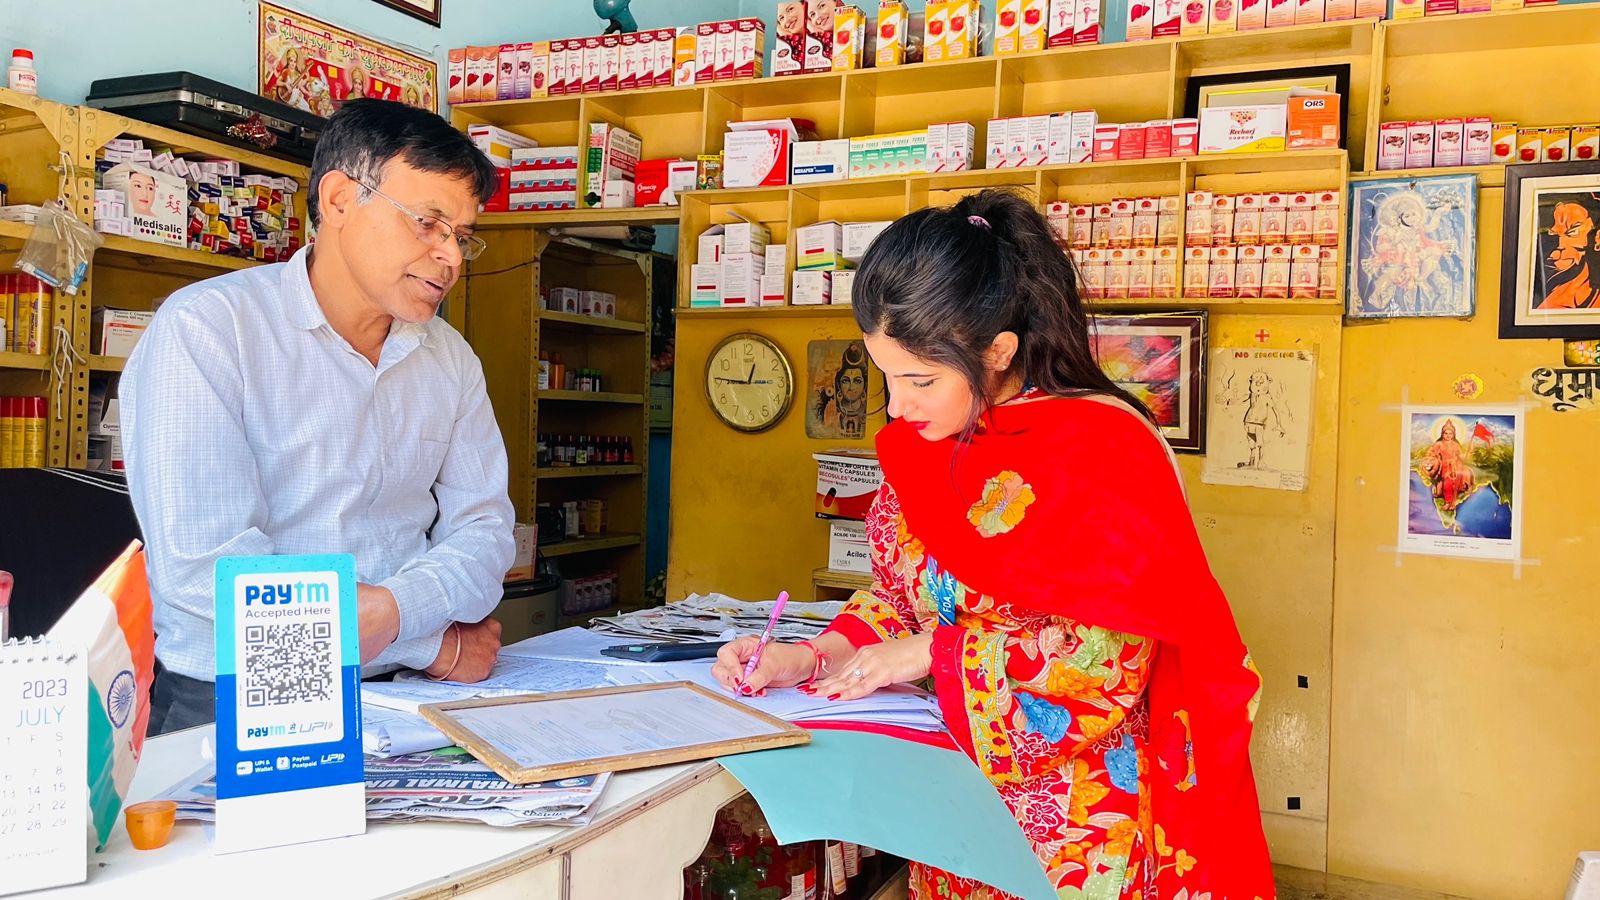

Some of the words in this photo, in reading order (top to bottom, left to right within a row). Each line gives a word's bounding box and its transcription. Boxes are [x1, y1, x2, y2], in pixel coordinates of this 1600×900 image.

[133, 216, 182, 234] Medisalic
[730, 348, 737, 359] 11
[743, 344, 753, 355] 12
[762, 347, 765, 358] 1
[721, 359, 730, 371] 10
[771, 359, 779, 371] 2
[778, 377, 785, 388] 3
[720, 393, 727, 404] 8
[773, 394, 780, 404] 4
[733, 405, 739, 417] 7
[747, 410, 754, 421] 6
[762, 405, 769, 417] 5
[818, 464, 838, 472] VITAMIN
[844, 469, 876, 477] CAPSULES
[850, 477, 880, 485] CAPSULES
[846, 550, 867, 559] Aciloc
[245, 607, 301, 619] Accepted
[304, 607, 331, 615] Here
[23, 678, 67, 699] 2023
[16, 704, 66, 728] JULY
[299, 721, 330, 733] UPI
[55, 732, 64, 742] S
[292, 761, 318, 769] Postpaid
[56, 767, 62, 776] 8
[28, 786, 40, 795] 14
[53, 783, 65, 792] 15
[52, 800, 66, 810] 22
[27, 821, 41, 831] 28
[52, 817, 66, 827] 29
